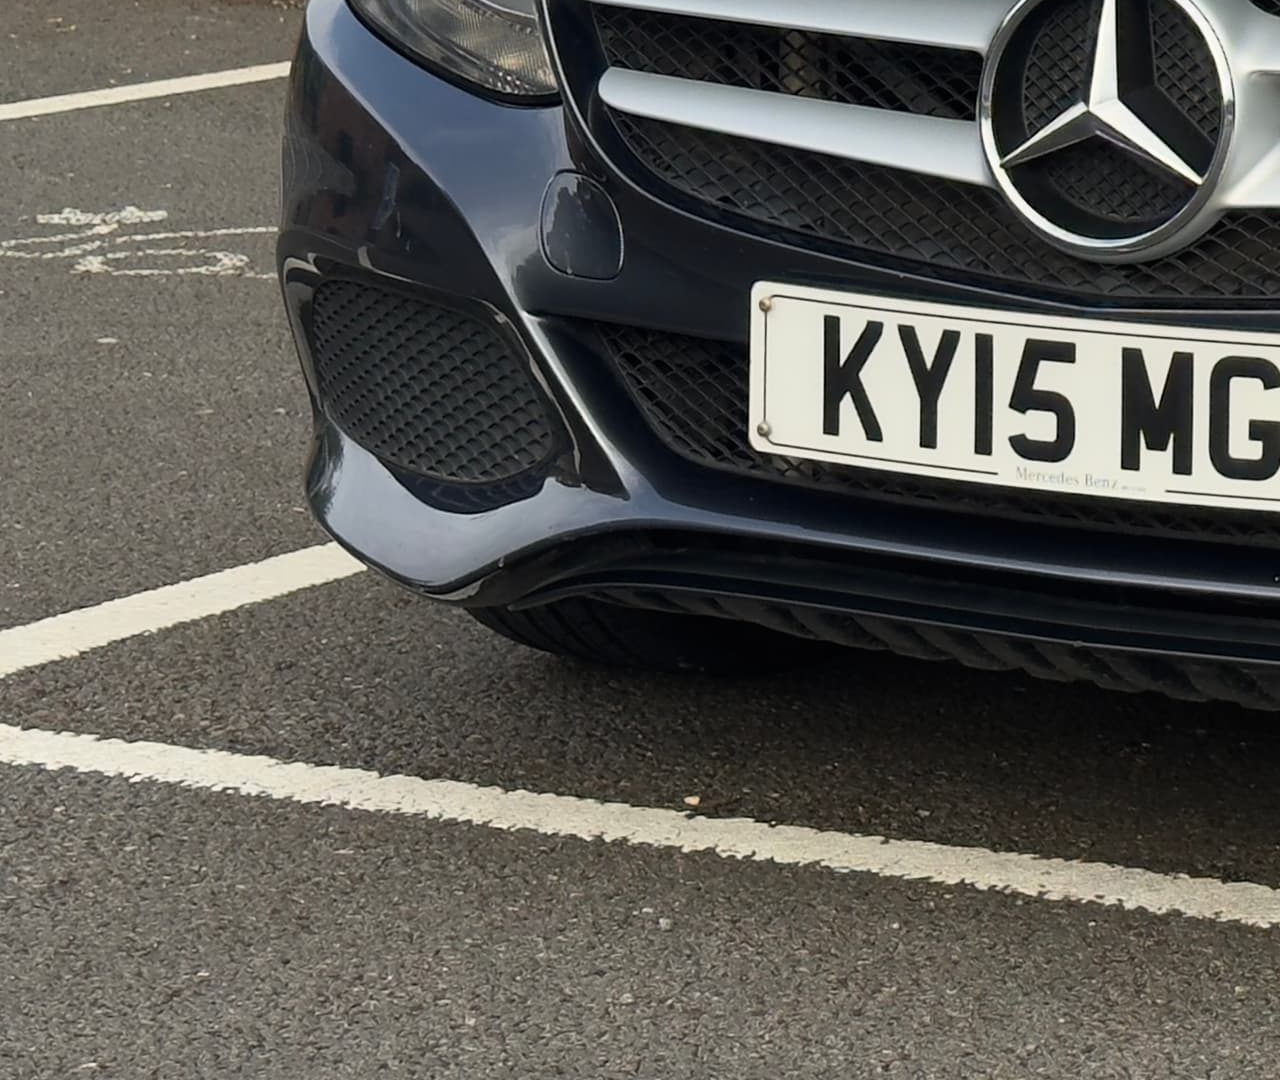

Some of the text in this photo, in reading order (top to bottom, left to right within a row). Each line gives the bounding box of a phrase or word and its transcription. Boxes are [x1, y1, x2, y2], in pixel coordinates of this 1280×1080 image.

[823, 315, 1076, 463] KY15
[1016, 466, 1118, 489] Mercedes Benz
